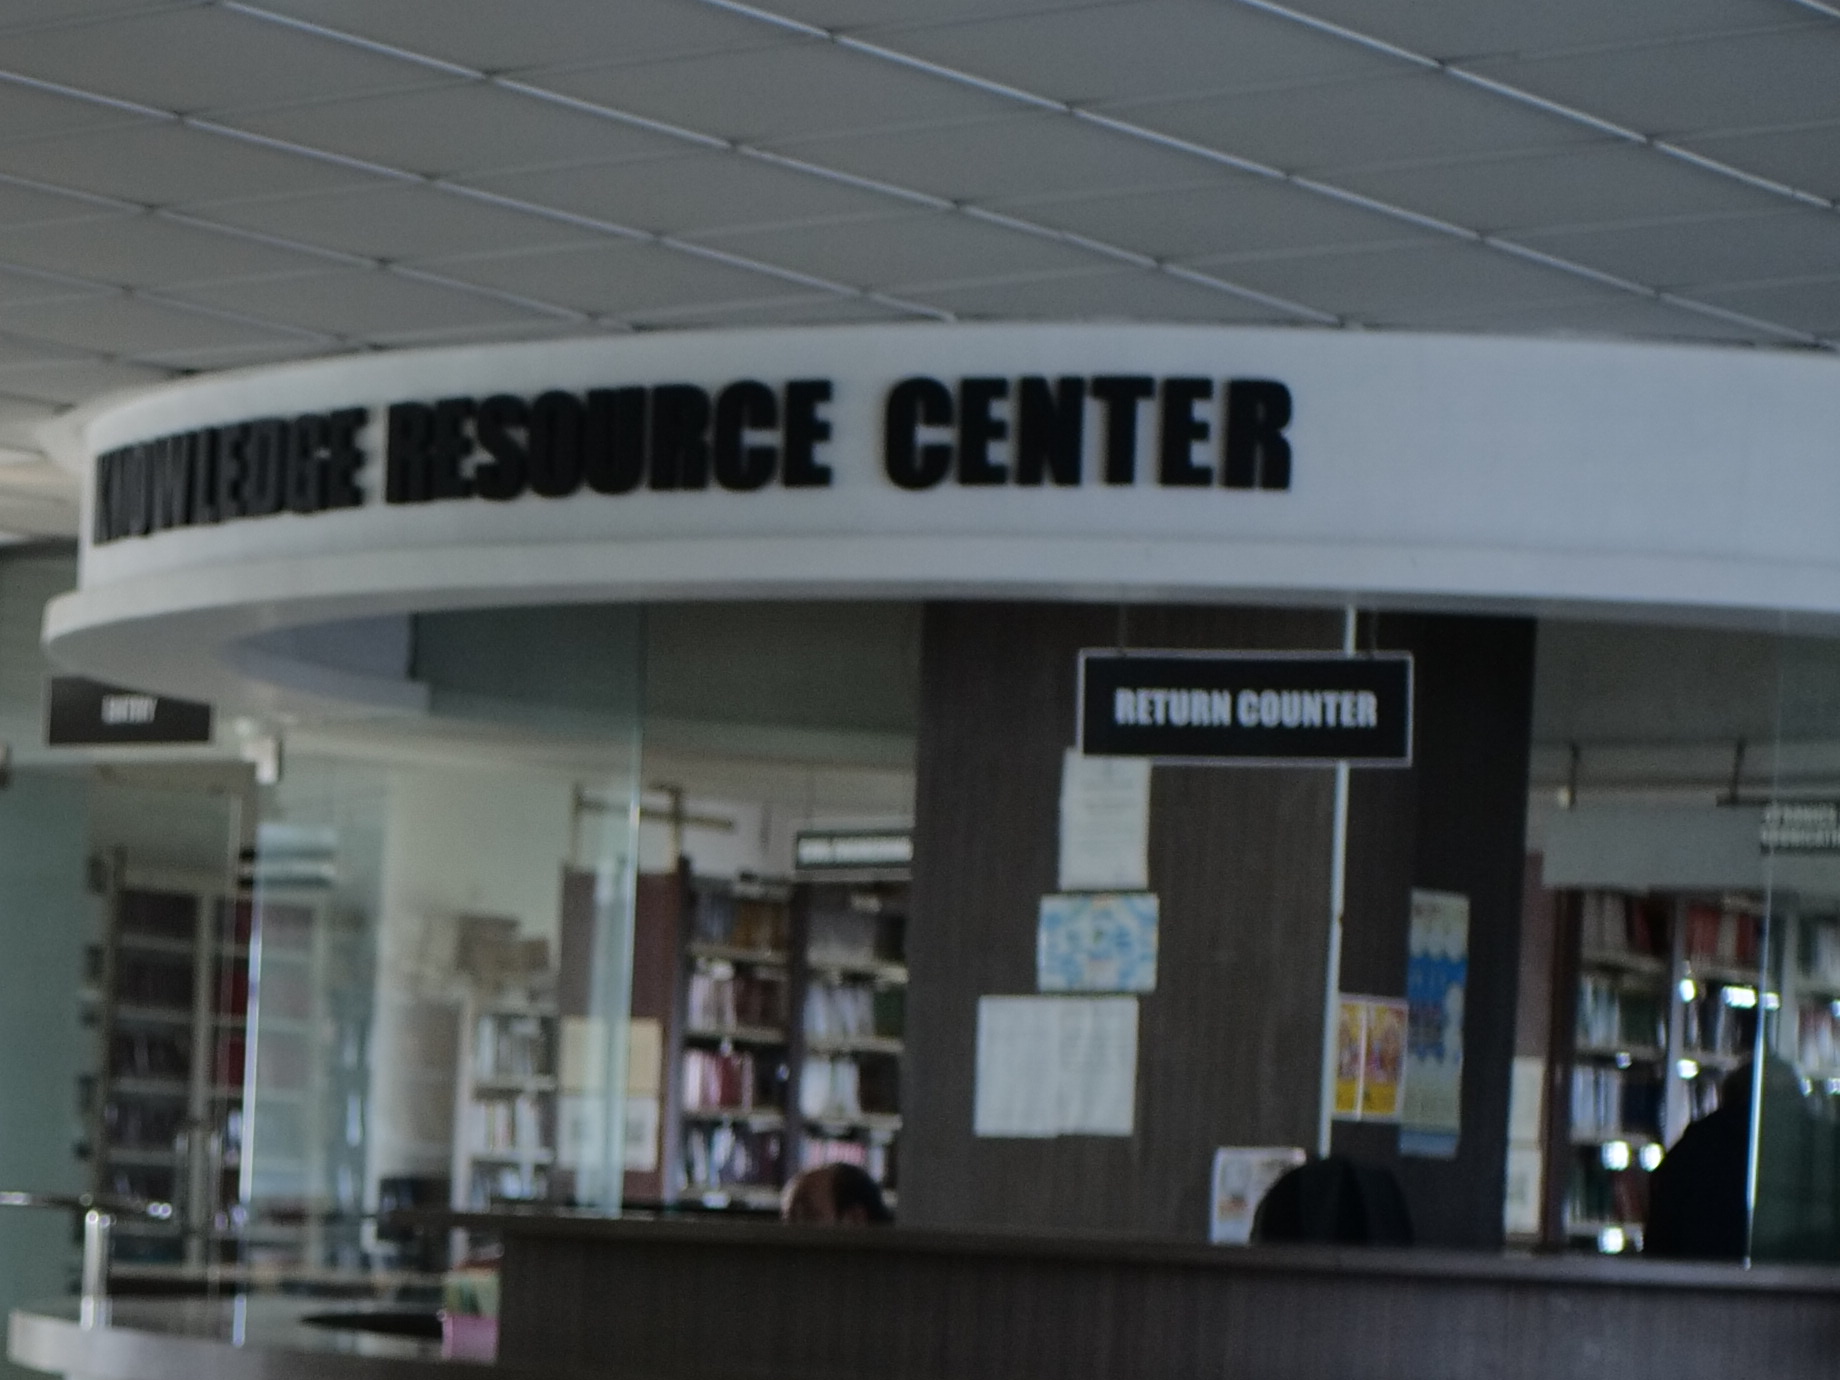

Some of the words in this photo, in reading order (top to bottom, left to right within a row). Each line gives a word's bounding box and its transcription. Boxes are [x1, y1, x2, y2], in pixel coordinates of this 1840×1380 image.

[385, 379, 834, 505] RESOURCE
[882, 375, 1293, 491] CENTER
[1114, 687, 1232, 726] RETURN
[1236, 689, 1378, 728] COUNTER
